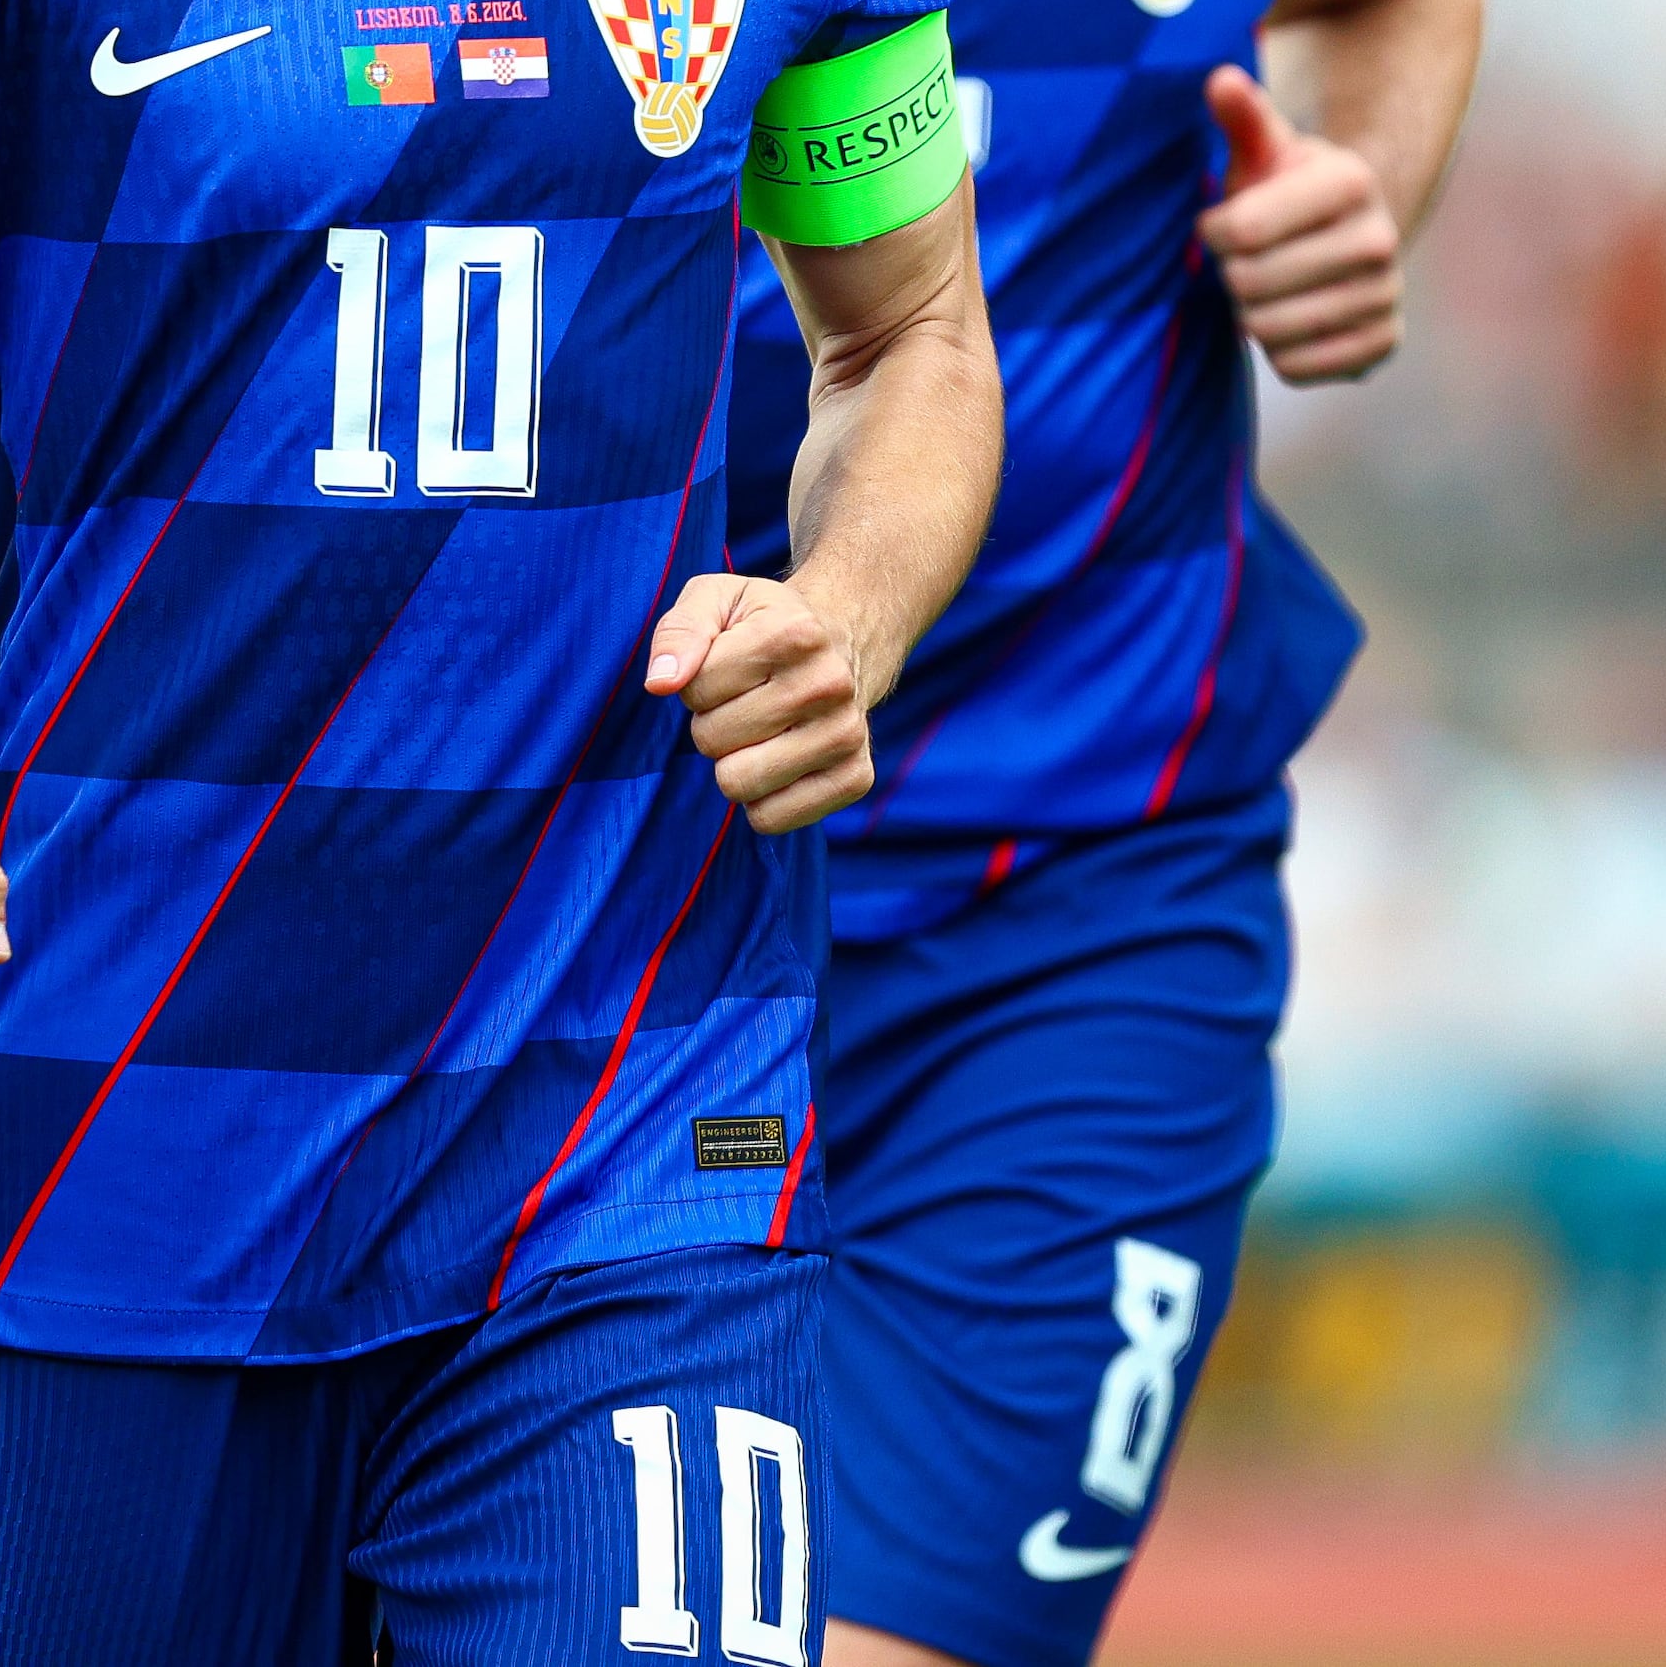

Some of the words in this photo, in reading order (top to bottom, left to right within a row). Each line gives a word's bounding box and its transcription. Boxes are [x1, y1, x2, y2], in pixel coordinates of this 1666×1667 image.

[355, 5, 445, 30] LISABON,
[803, 68, 950, 173] RESPECT
[314, 225, 544, 498] 10
[1080, 1236, 1203, 1517] 8
[612, 1404, 810, 1667] 10
